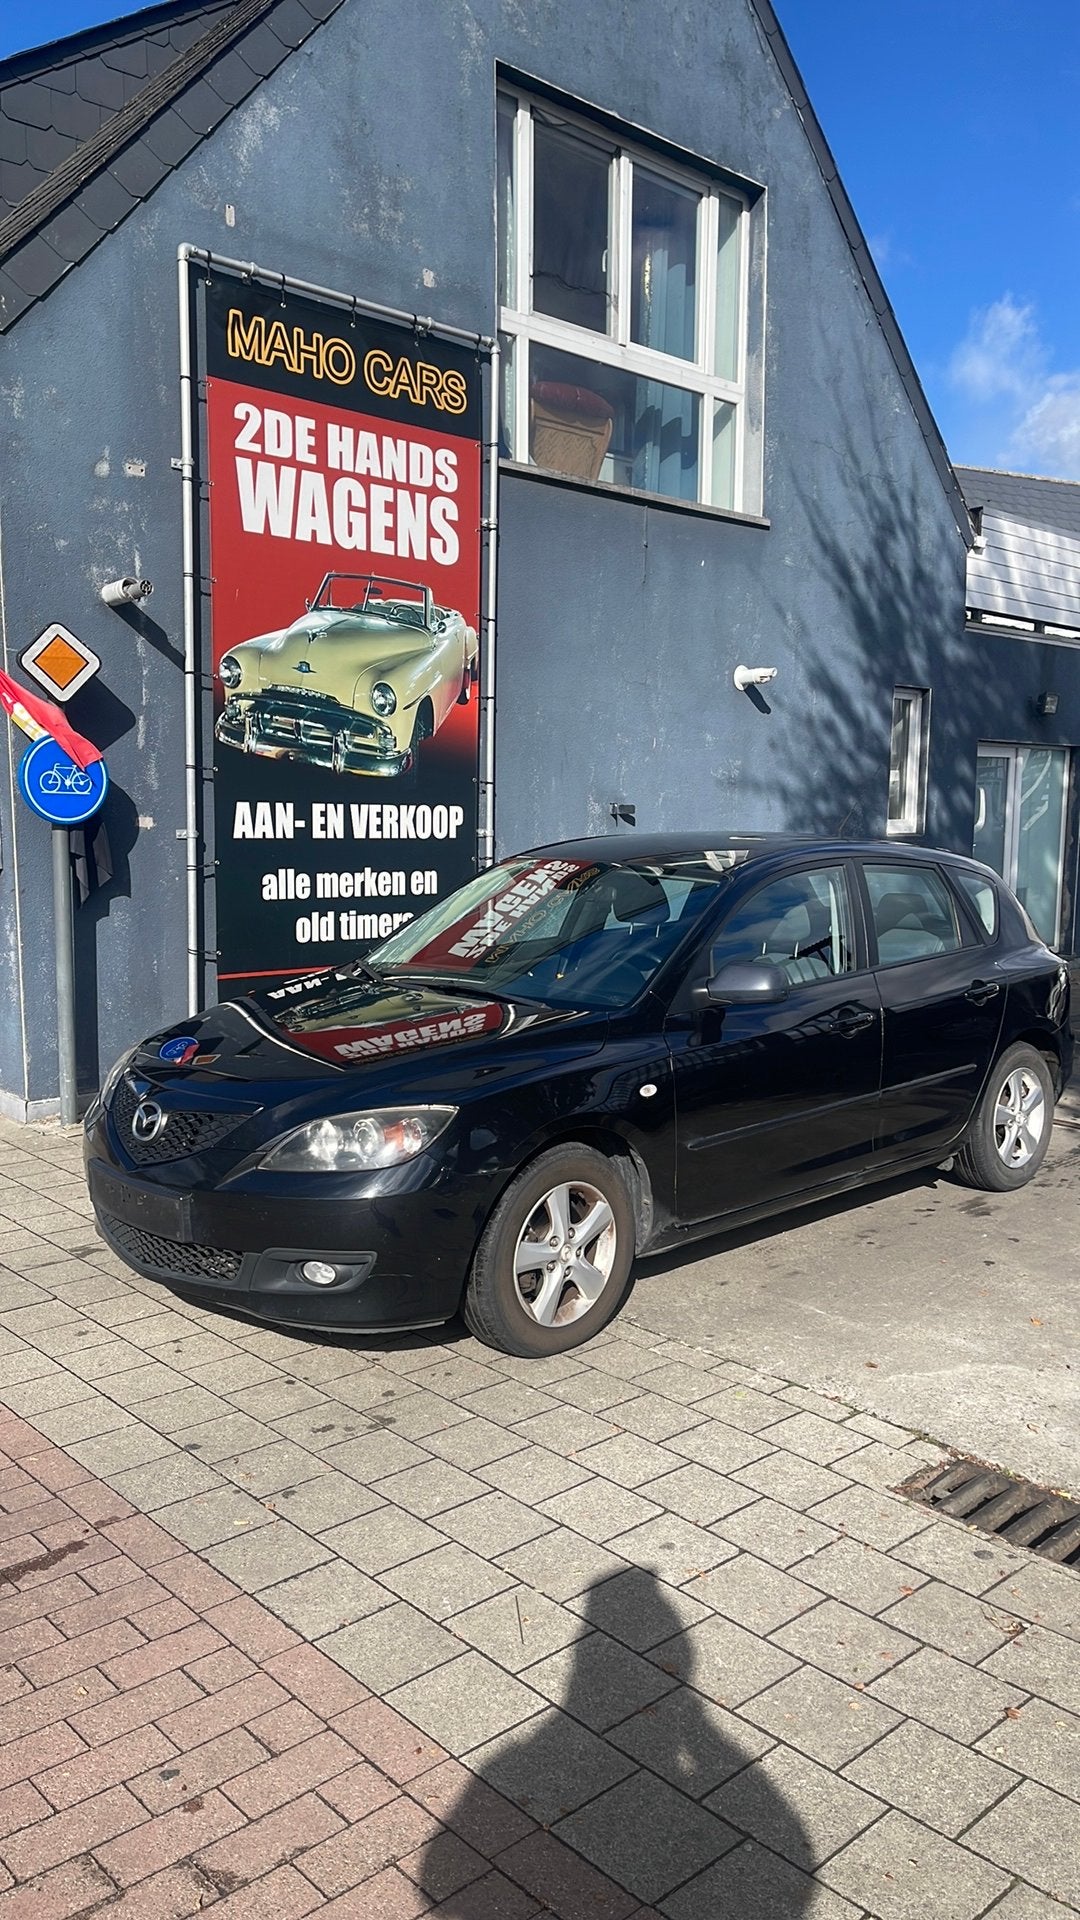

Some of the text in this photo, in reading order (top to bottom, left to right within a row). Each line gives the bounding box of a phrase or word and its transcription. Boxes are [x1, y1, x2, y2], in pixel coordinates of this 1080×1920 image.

[227, 308, 468, 414] MAHO CARS
[233, 402, 458, 493] 2DE HANDS
[235, 456, 460, 566] WAGENS
[233, 801, 464, 839] AAN- EN VERKOOP
[262, 867, 438, 900] alle merken en
[295, 911, 335, 943] old
